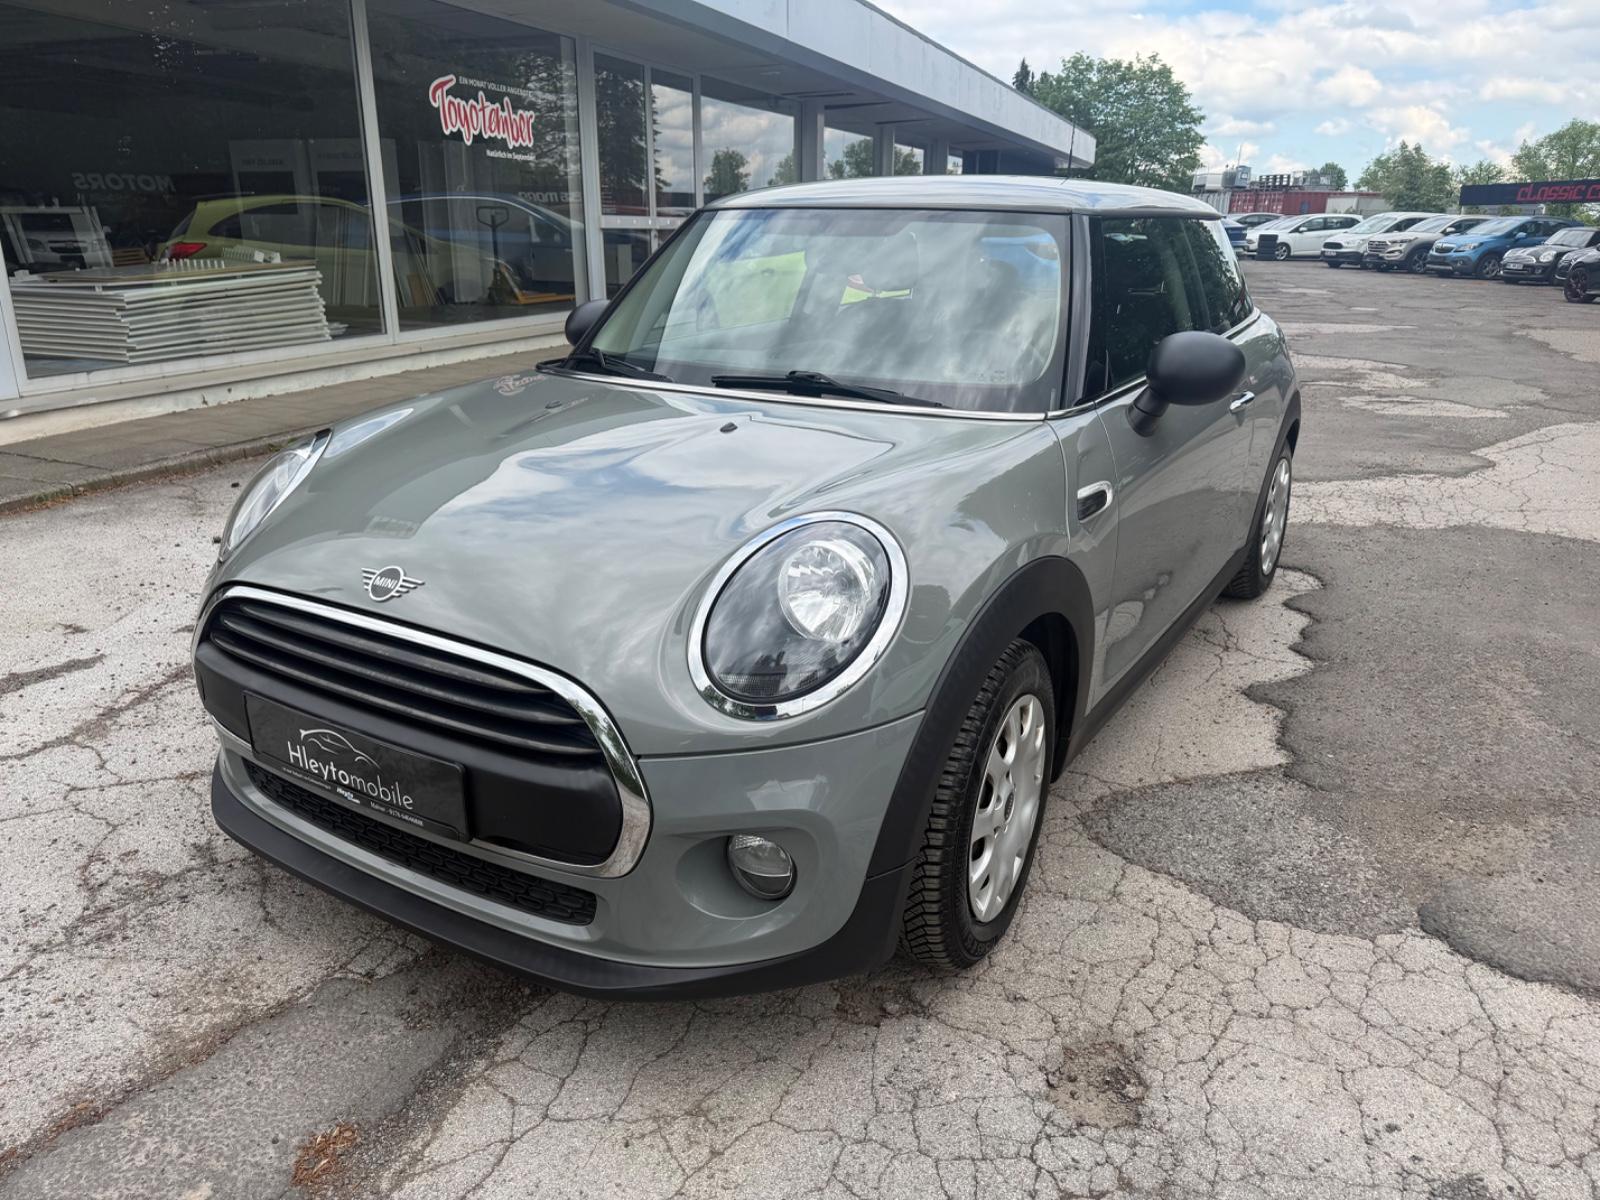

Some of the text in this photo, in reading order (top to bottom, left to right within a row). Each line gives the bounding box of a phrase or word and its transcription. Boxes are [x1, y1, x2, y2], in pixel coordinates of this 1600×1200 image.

[459, 75, 468, 85] EIN
[429, 74, 535, 149] Toyotember
[1516, 183, 1600, 201] CLASSIC C
[373, 576, 398, 589] MINI
